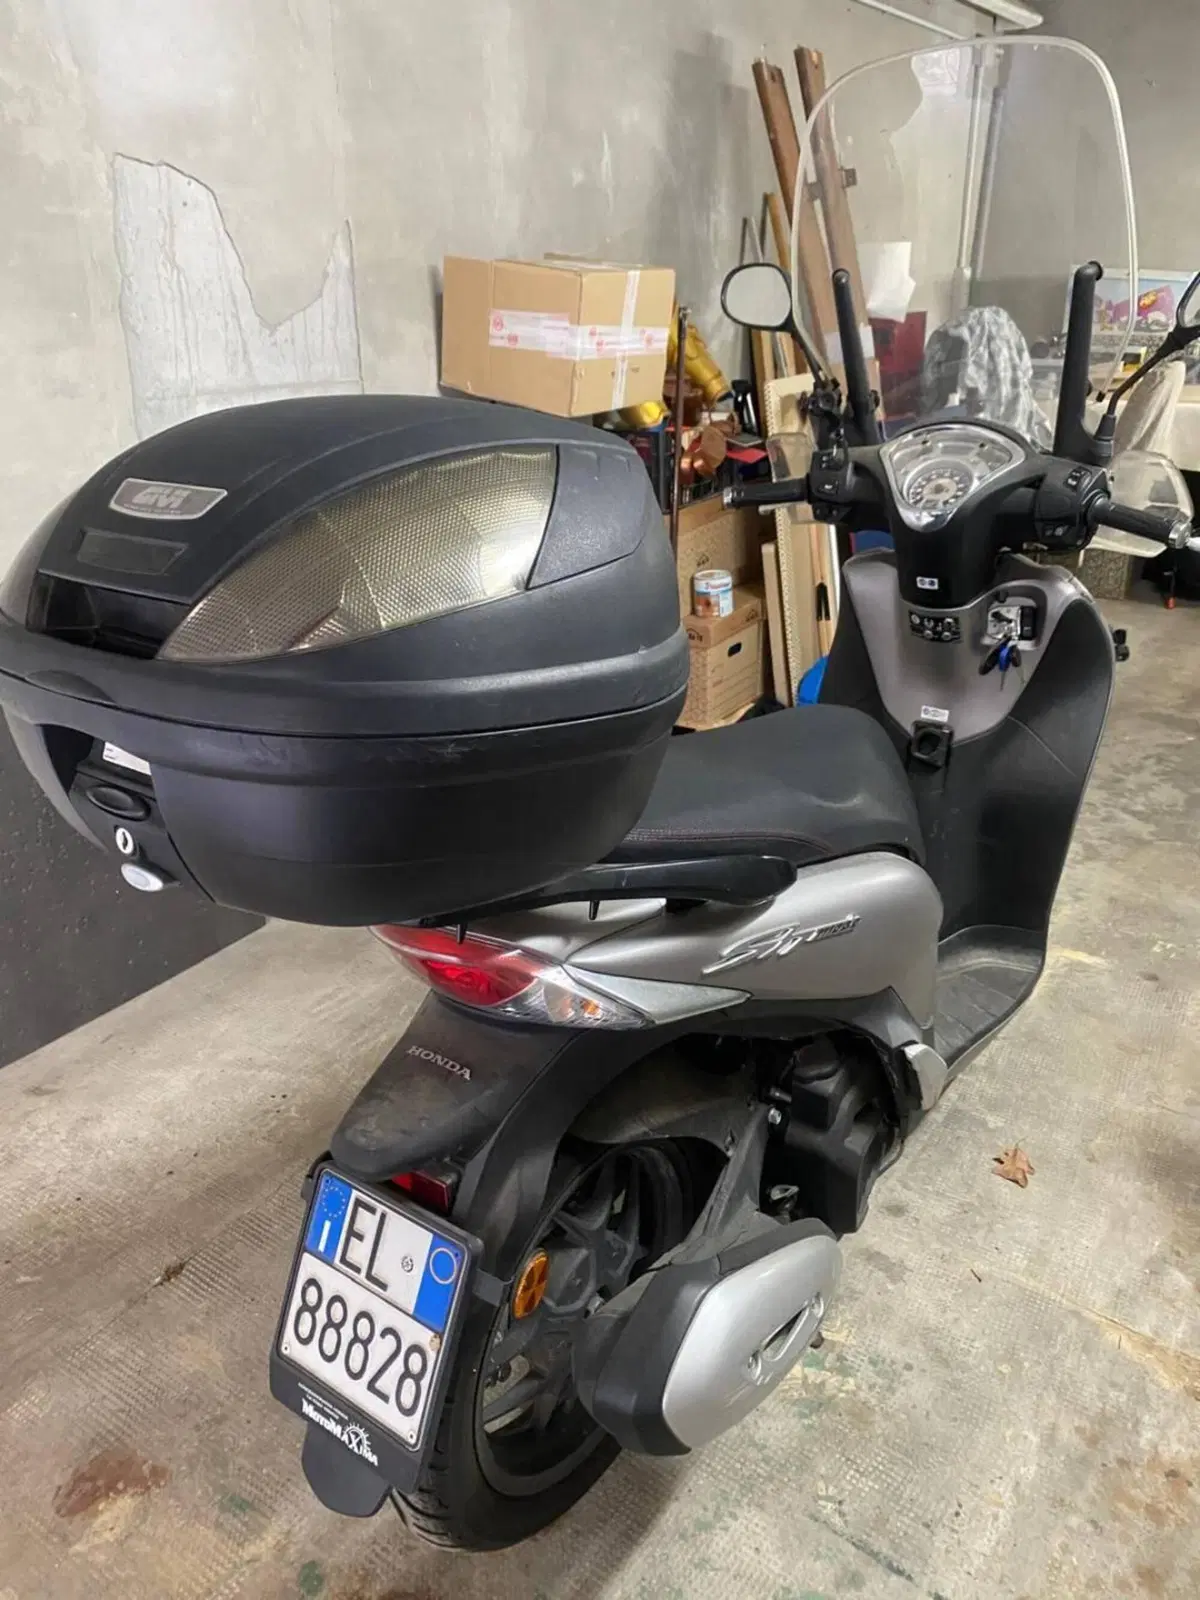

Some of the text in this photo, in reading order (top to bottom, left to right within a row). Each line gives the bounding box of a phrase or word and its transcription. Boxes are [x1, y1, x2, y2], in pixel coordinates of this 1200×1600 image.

[405, 1045, 472, 1081] HONDA
[339, 1196, 389, 1292] EL
[293, 1277, 428, 1418] 88828
